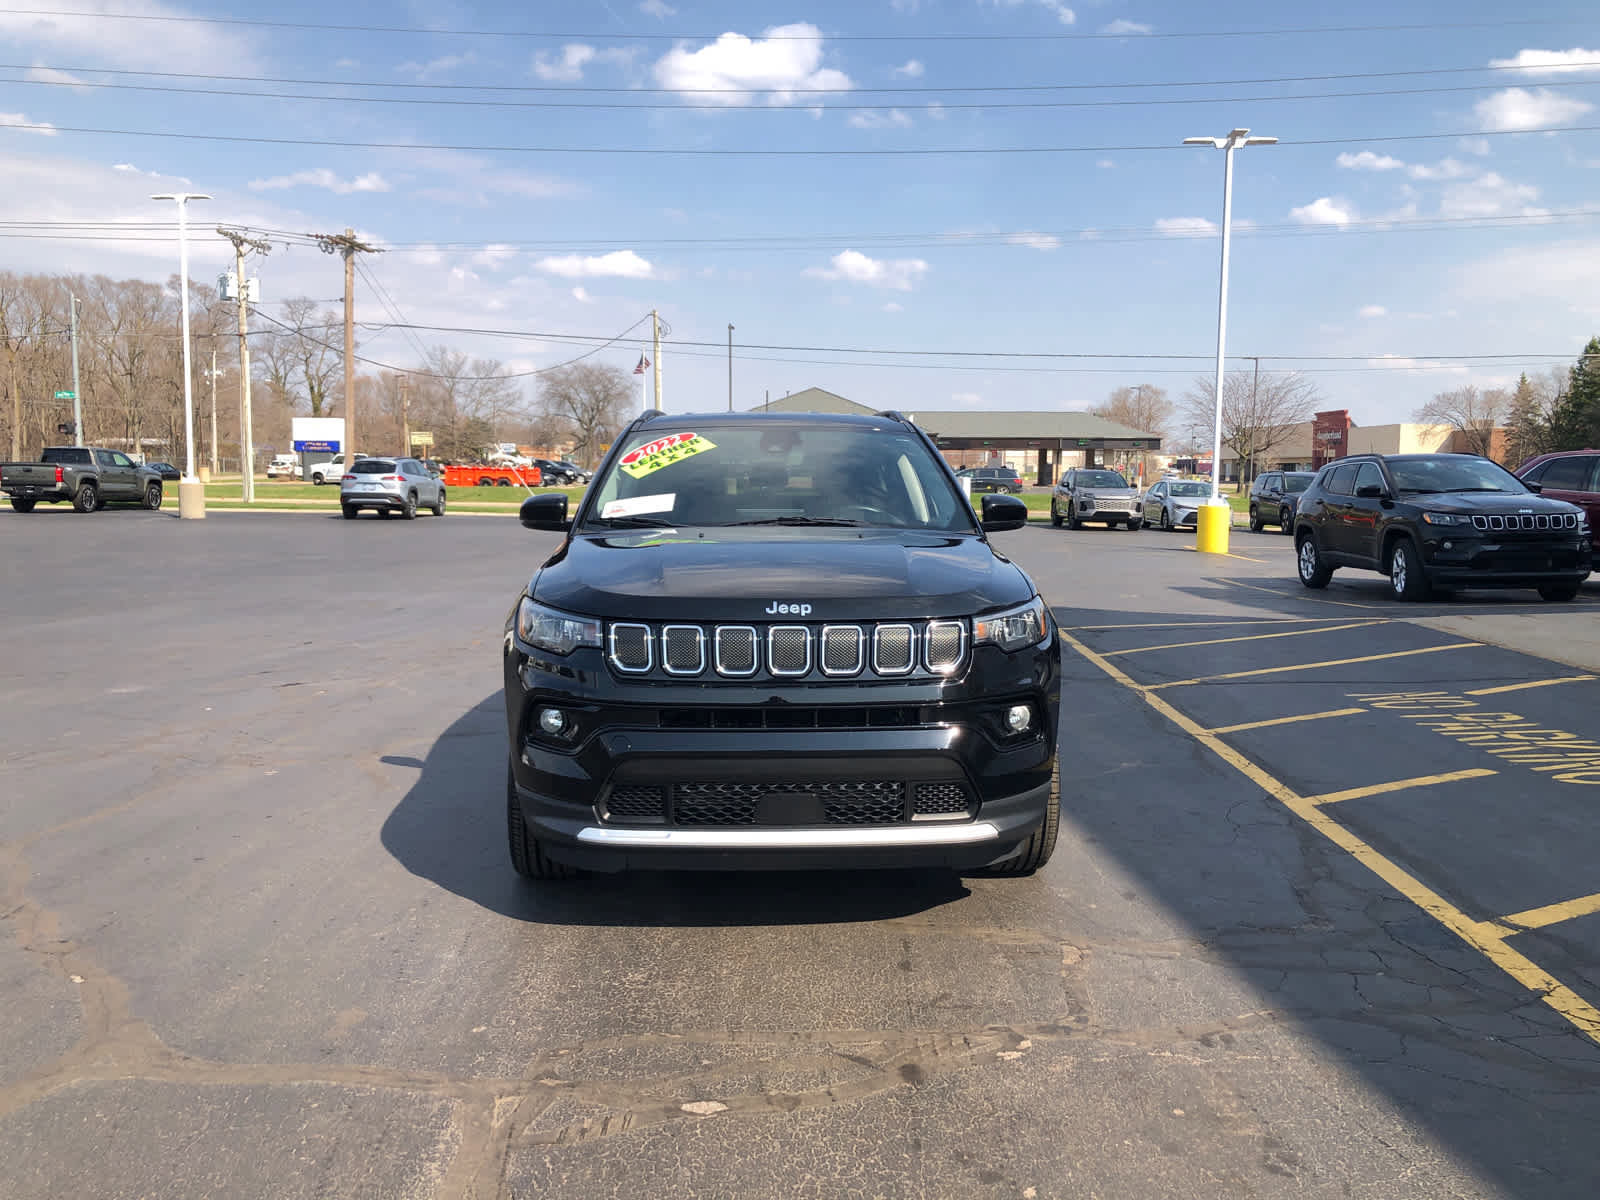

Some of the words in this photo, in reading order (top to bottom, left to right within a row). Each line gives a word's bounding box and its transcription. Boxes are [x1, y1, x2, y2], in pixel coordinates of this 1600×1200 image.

[629, 438, 701, 470] LEATHER
[637, 434, 681, 458] 2022
[765, 600, 812, 616] Jeep
